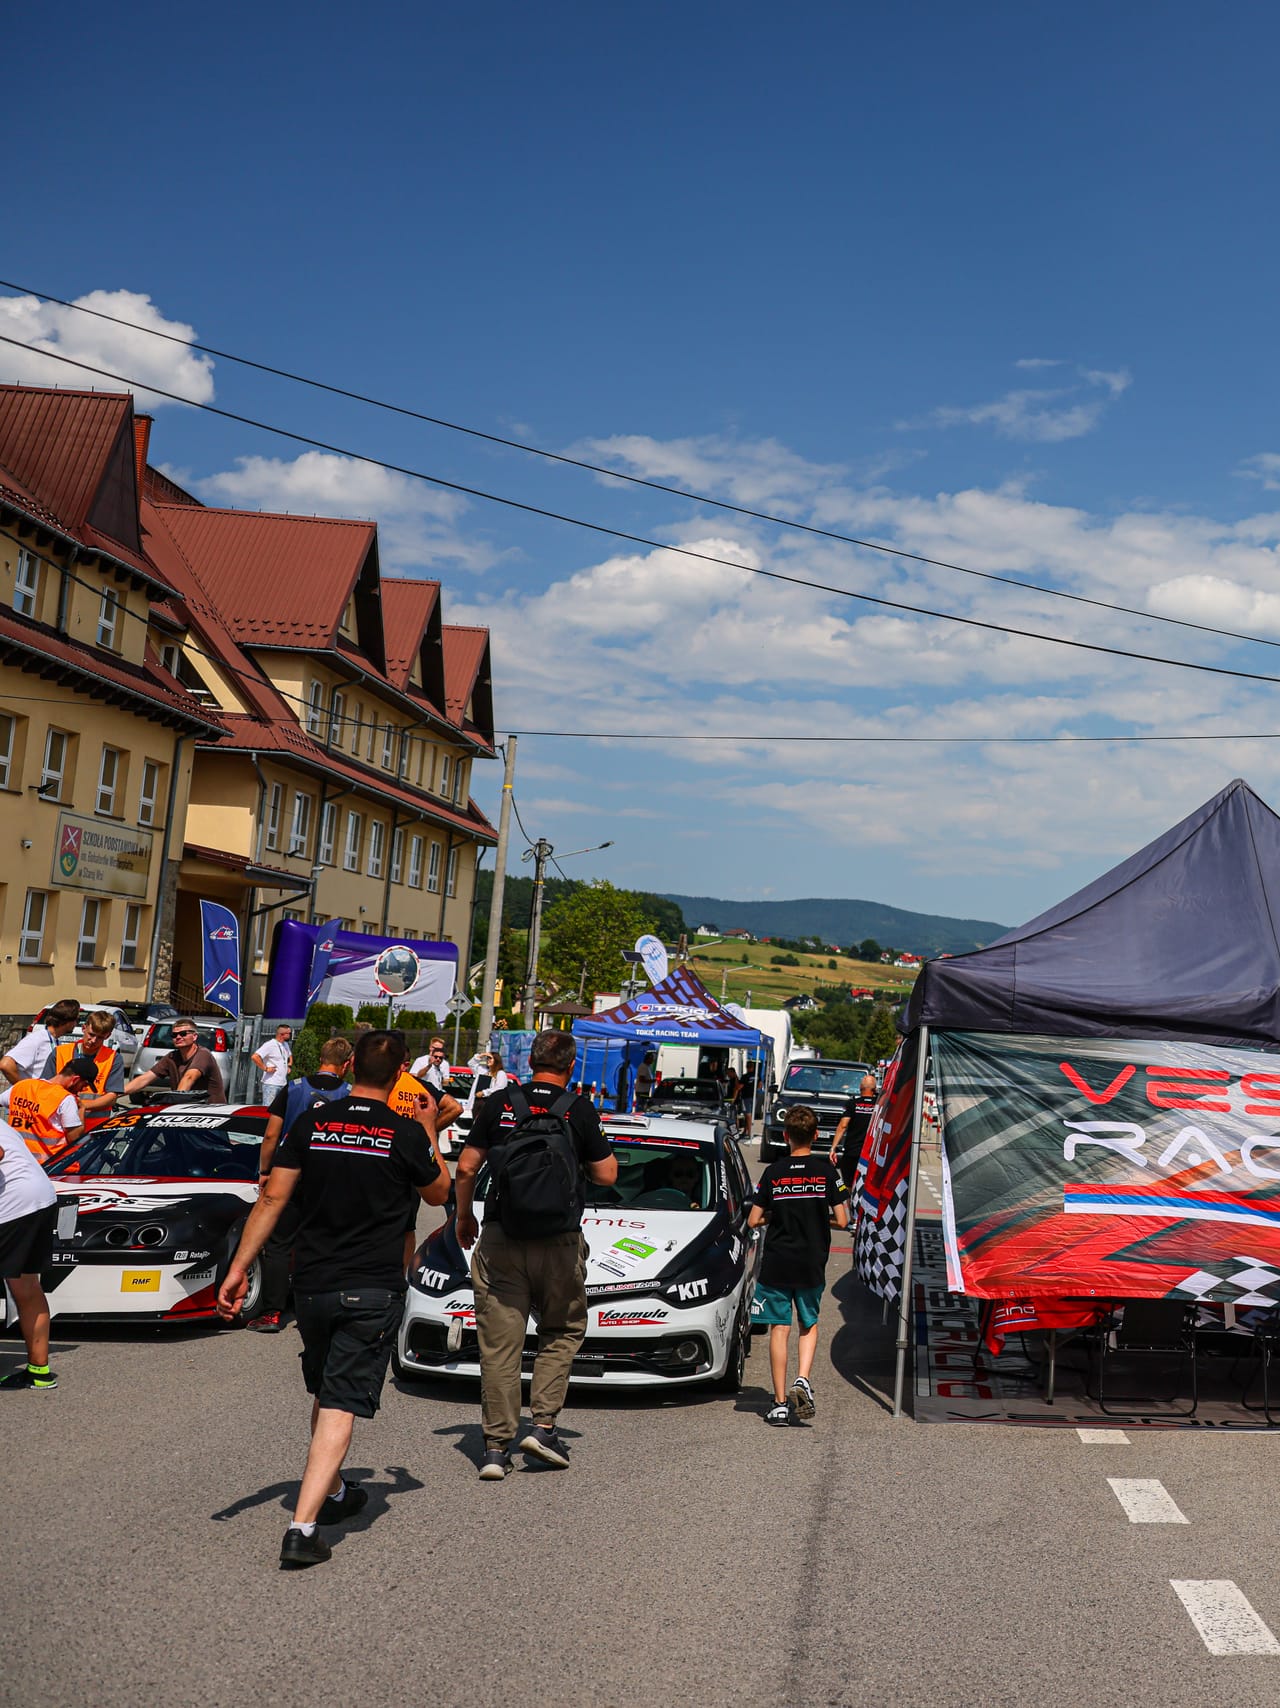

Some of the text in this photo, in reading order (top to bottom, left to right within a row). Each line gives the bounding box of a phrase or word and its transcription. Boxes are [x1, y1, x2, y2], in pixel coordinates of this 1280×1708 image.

[102, 1115, 142, 1129] 53
[314, 1121, 396, 1139] VESNIC
[311, 1132, 392, 1149] RACING
[772, 1177, 826, 1186] VESNIC
[772, 1185, 826, 1194] RACING
[63, 1254, 79, 1262] PL
[420, 1268, 450, 1290] KIT
[678, 1279, 708, 1301] KIT
[603, 1308, 669, 1319] formula
